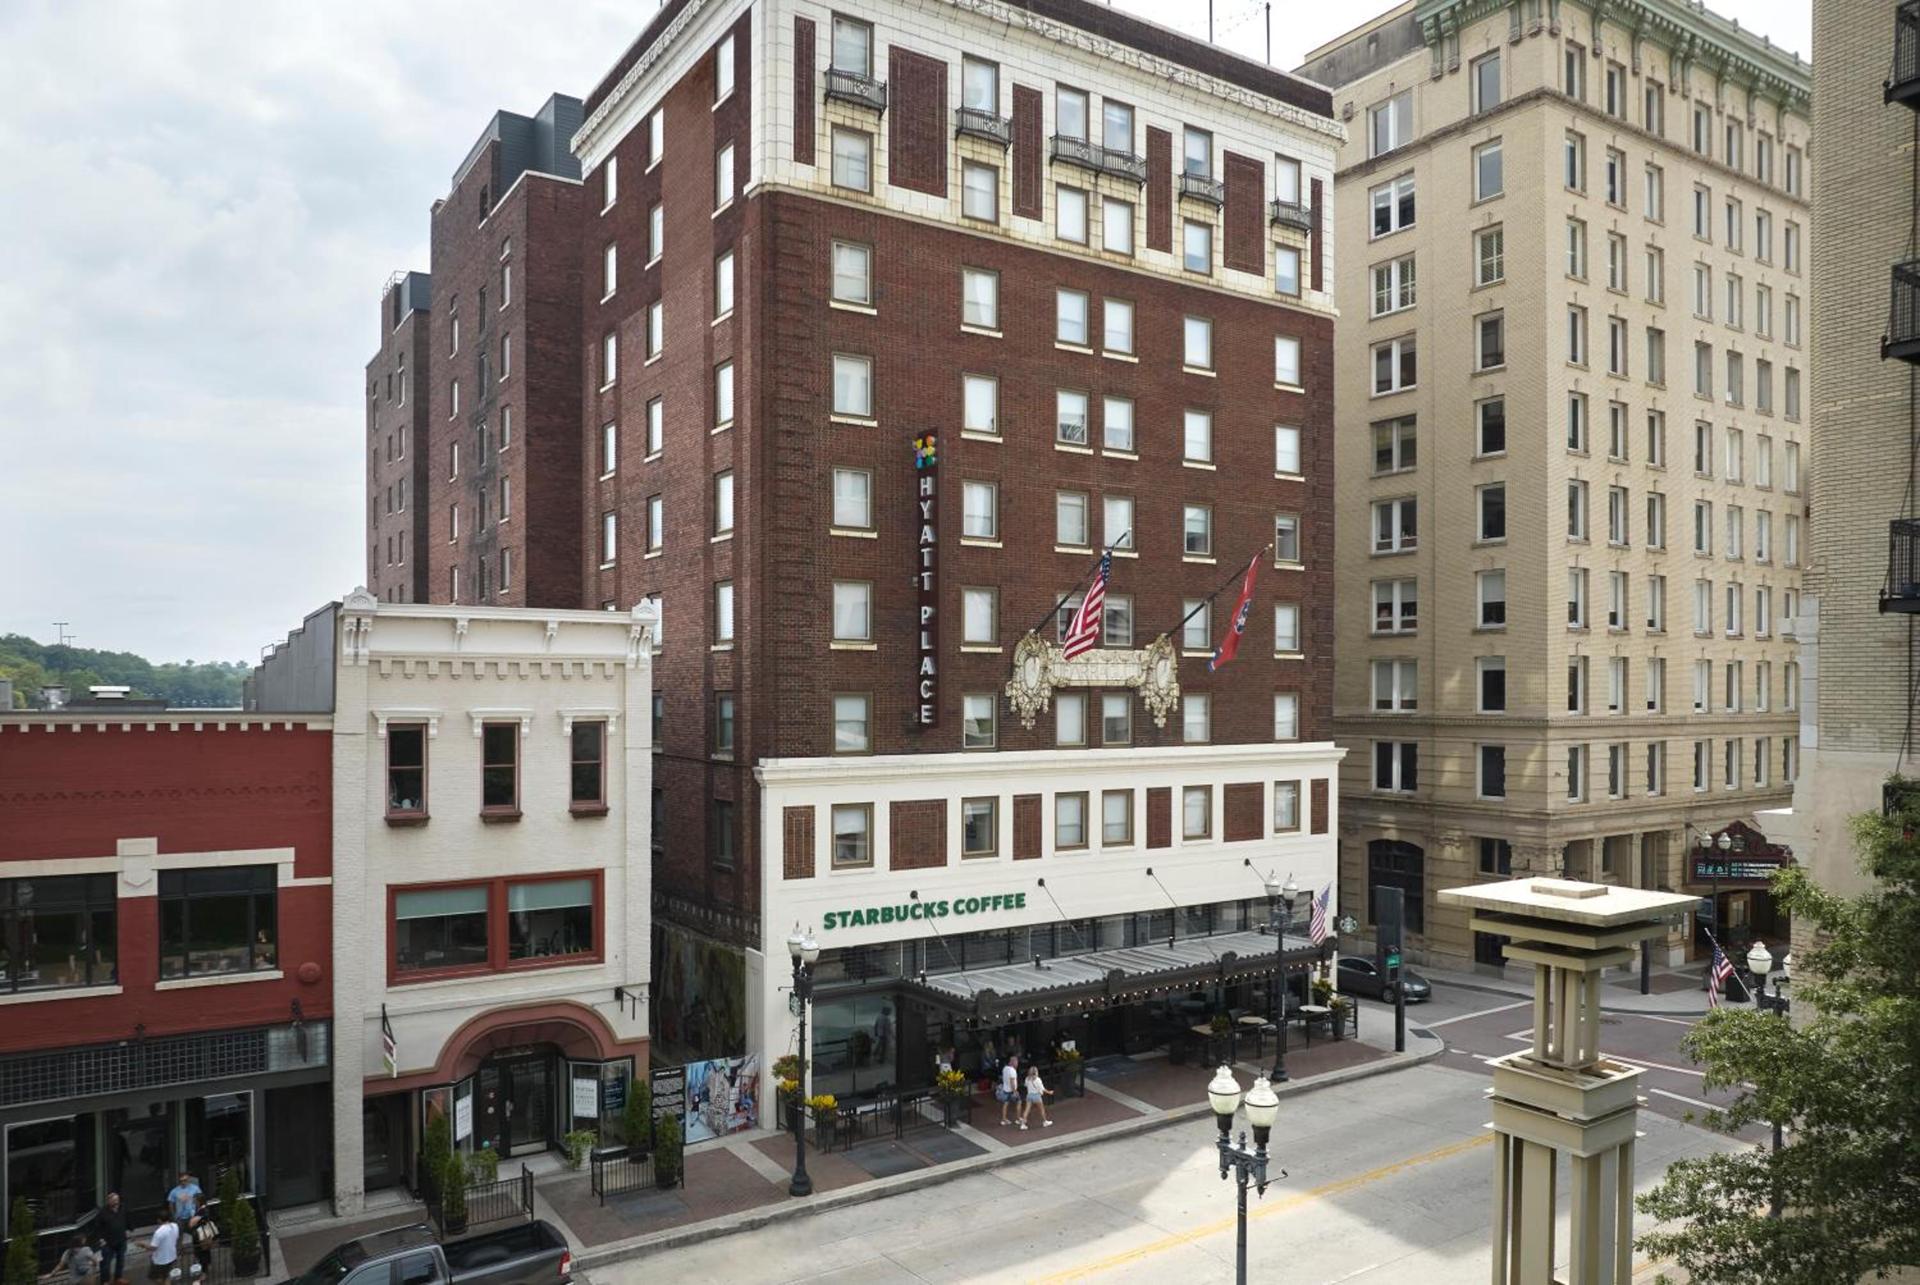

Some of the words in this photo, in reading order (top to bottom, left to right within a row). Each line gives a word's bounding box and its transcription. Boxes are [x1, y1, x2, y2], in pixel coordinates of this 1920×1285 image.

[919, 476, 935, 591] HYATT
[919, 605, 935, 724] PLACE
[825, 901, 948, 931] STARBUCKS
[953, 893, 1025, 913] COFFEE
